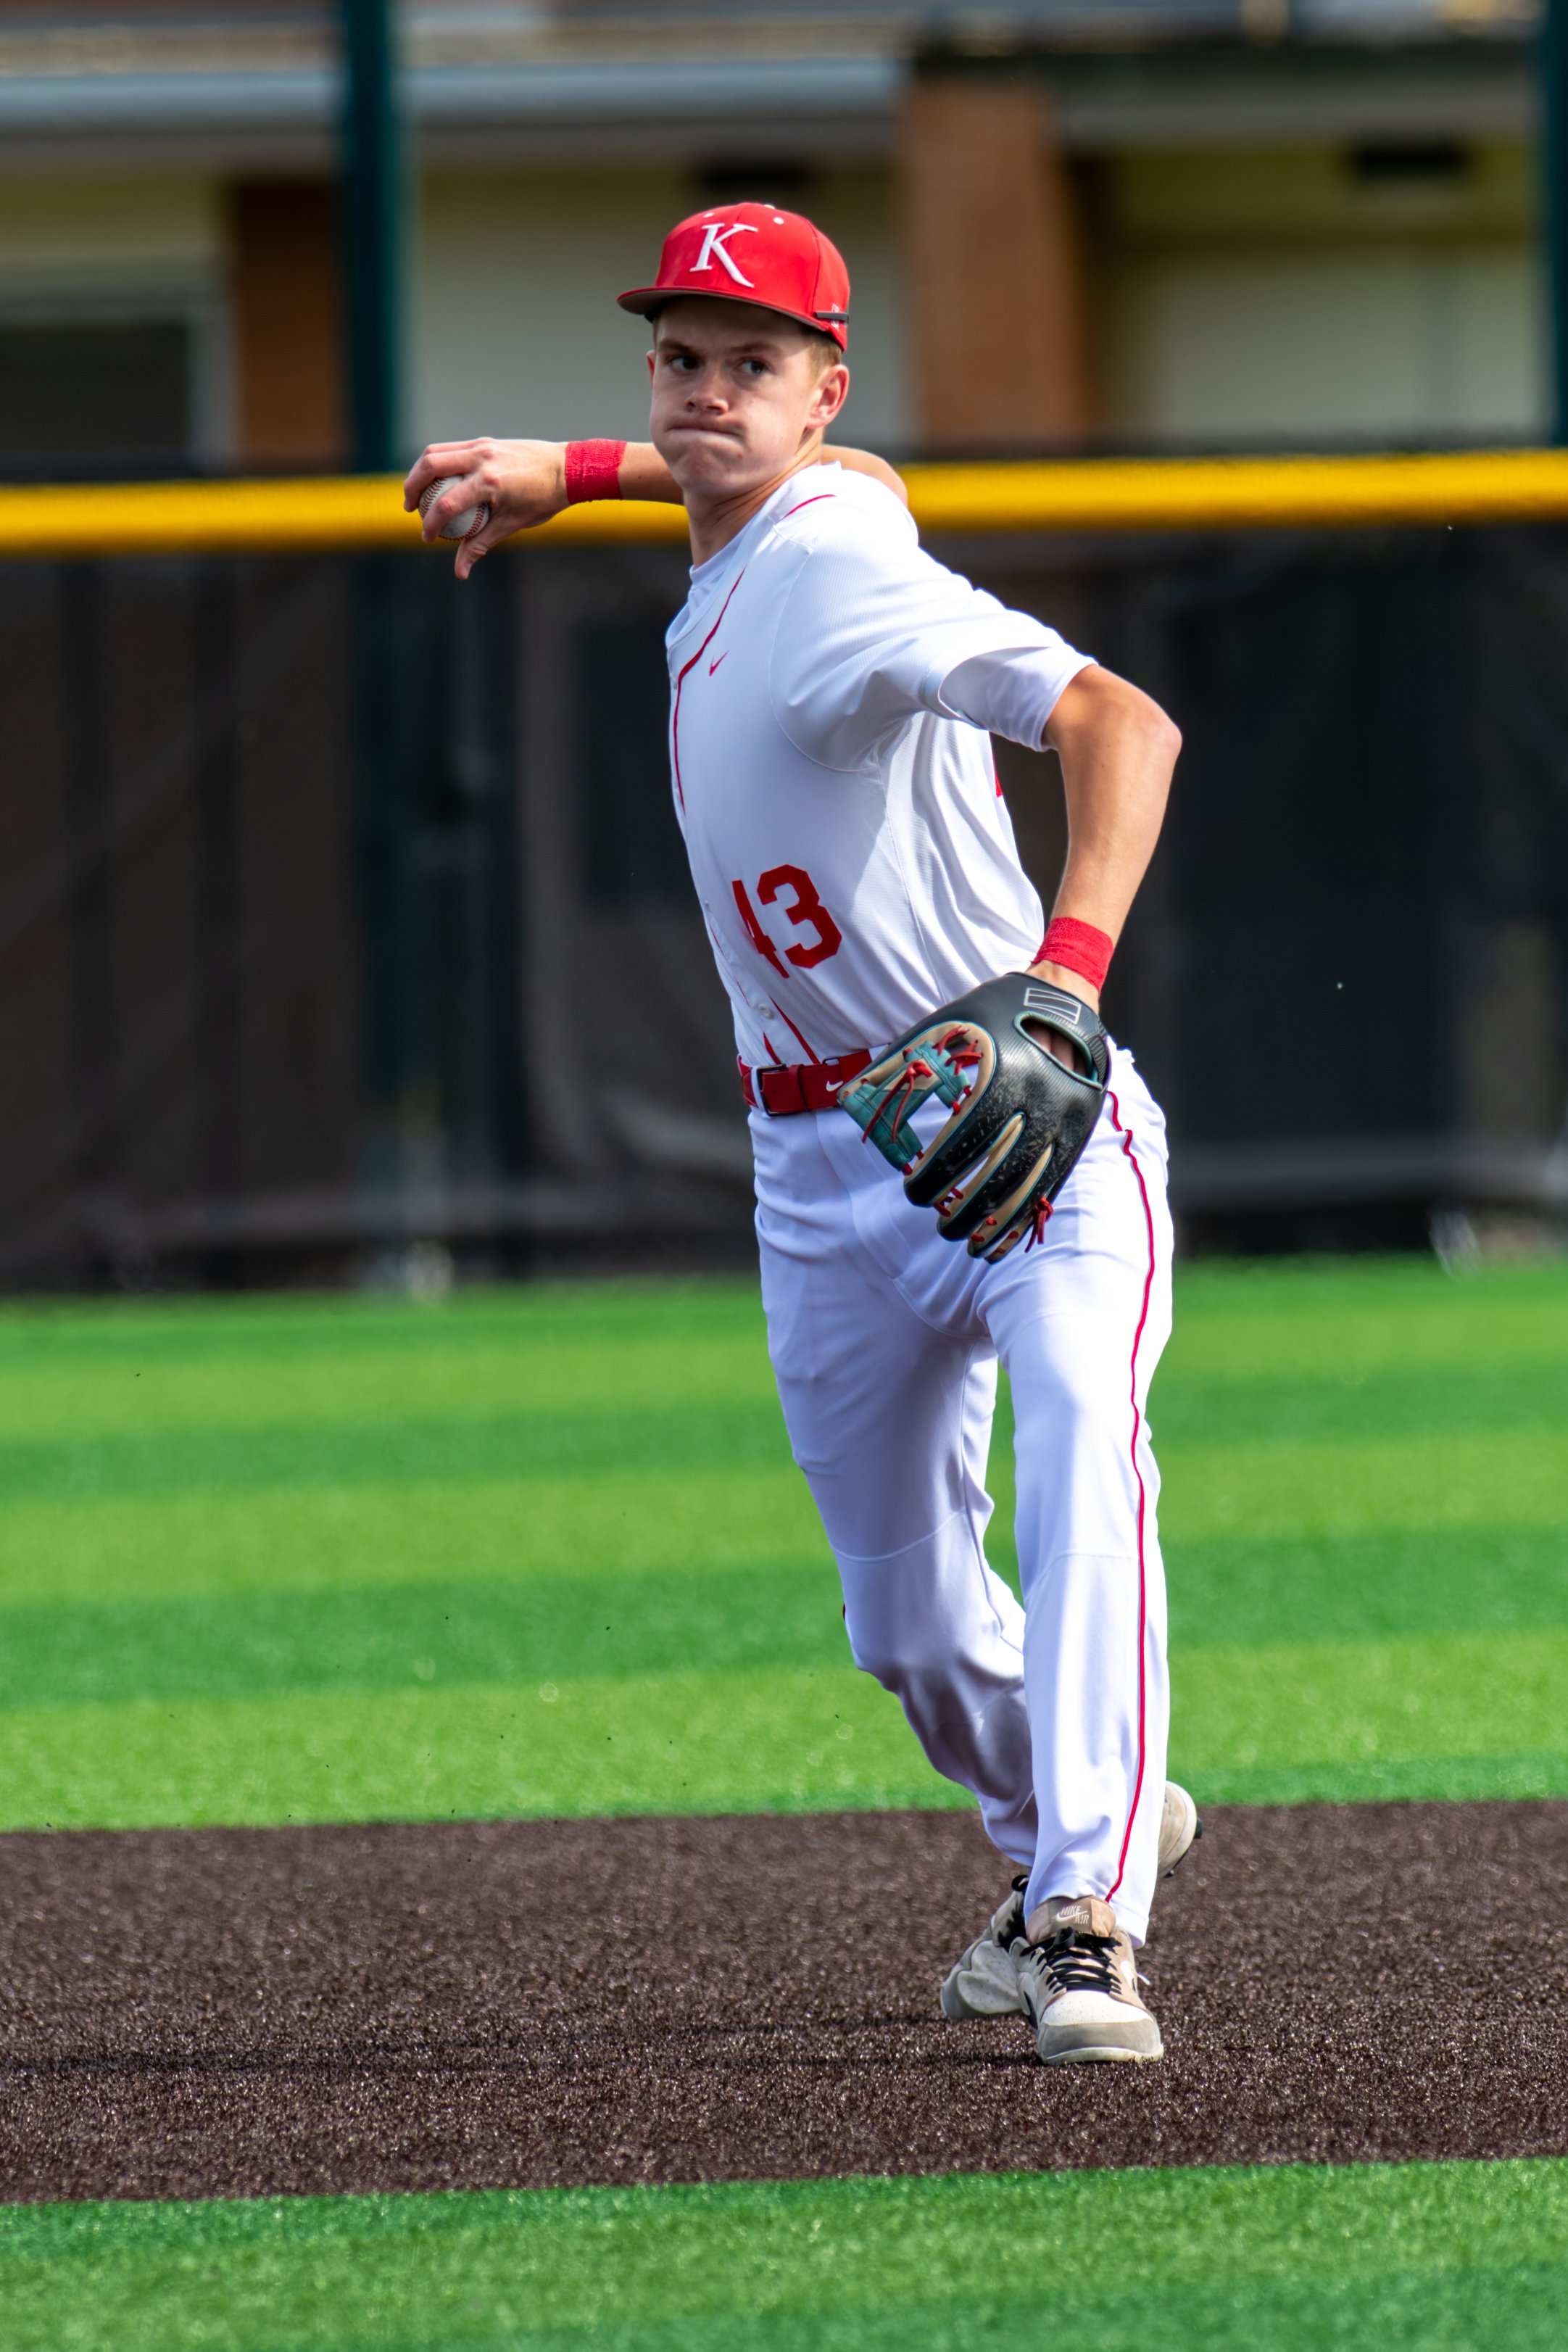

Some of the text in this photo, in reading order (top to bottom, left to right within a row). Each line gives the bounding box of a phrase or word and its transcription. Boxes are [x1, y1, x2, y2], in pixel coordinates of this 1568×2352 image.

[689, 223, 758, 288] K
[731, 864, 842, 978] 43
[1061, 1905, 1082, 1916] NIKE
[1074, 1914, 1090, 1925] AIR
